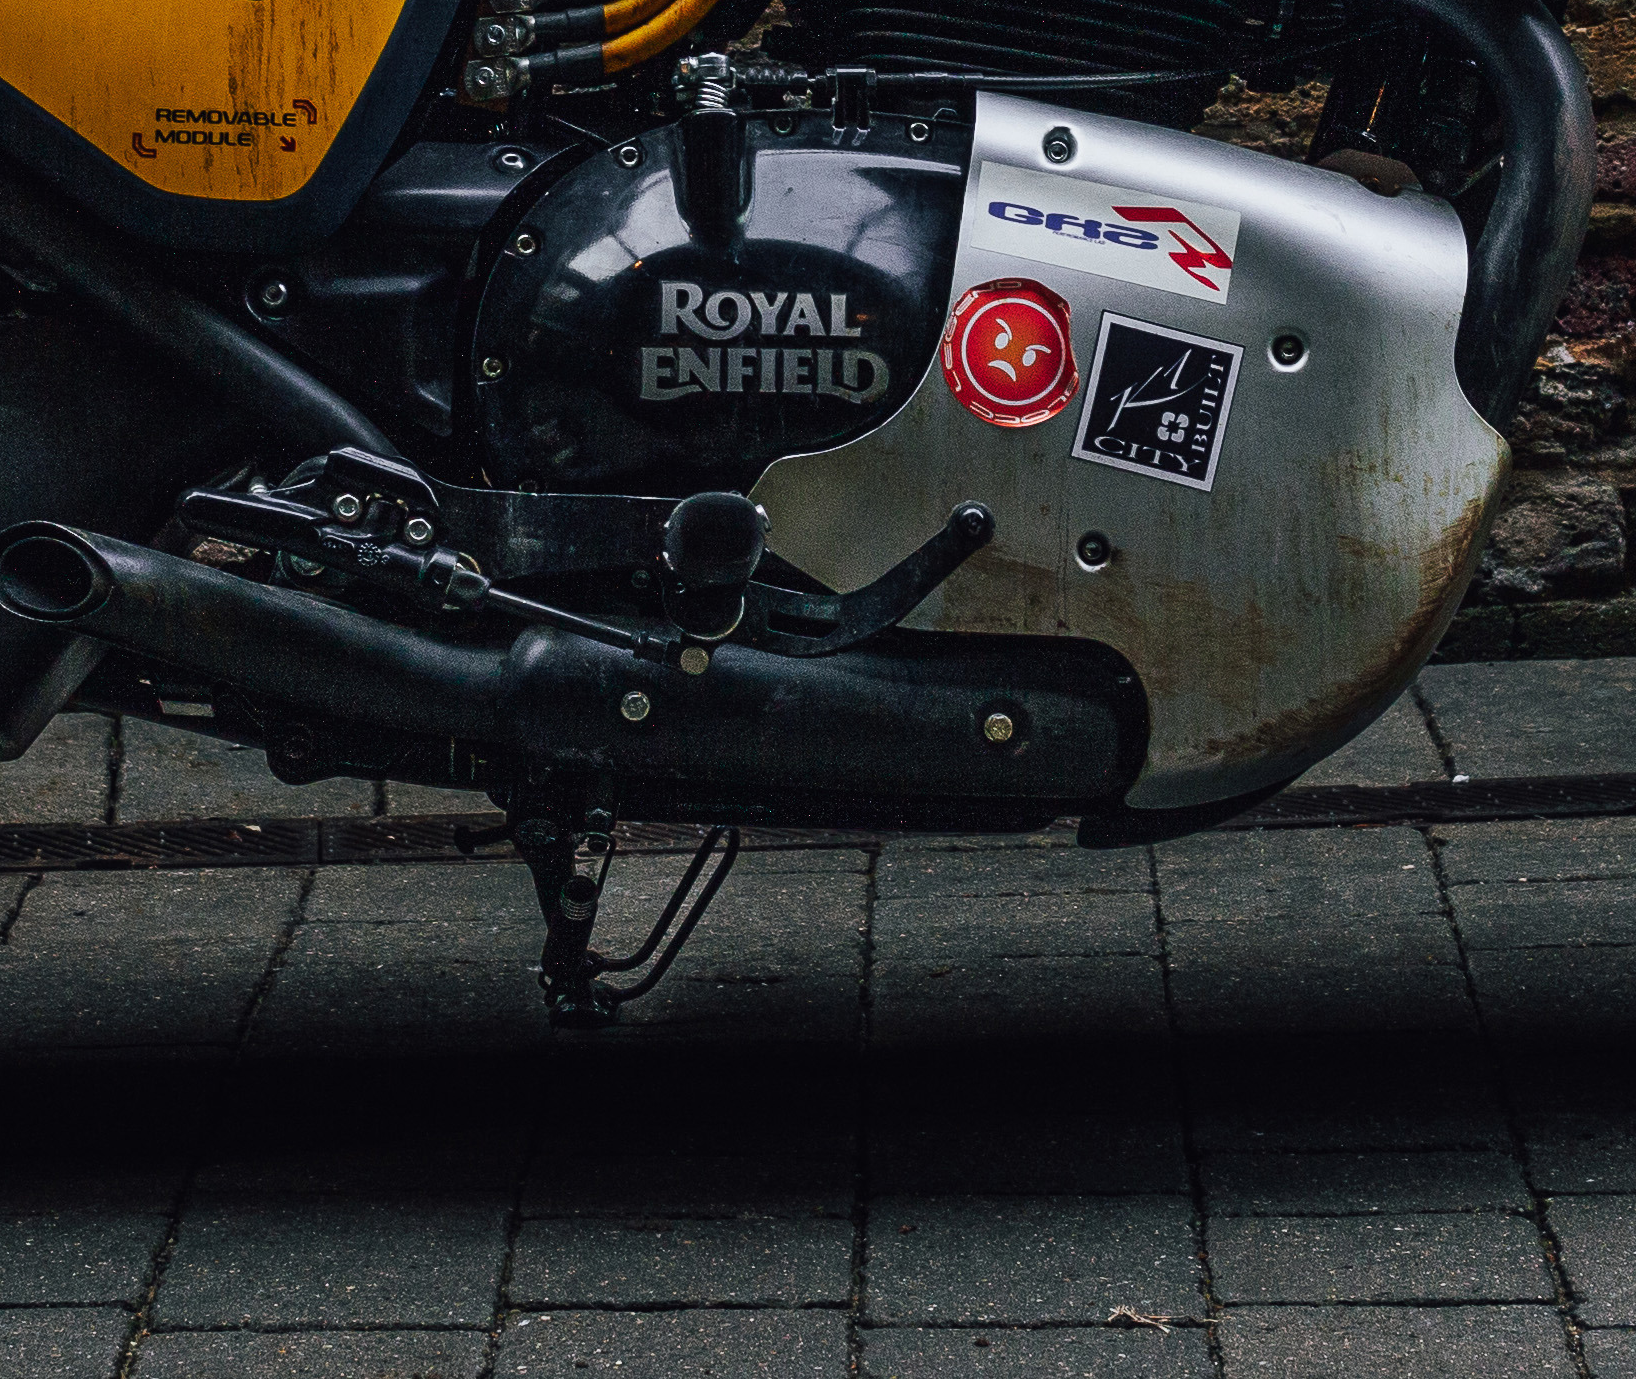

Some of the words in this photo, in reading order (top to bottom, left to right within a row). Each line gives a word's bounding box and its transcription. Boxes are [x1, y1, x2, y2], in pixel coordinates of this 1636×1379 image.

[154, 129, 253, 147] MODULE
[155, 108, 297, 127] REMOVABLE
[660, 280, 862, 341] ROYAL
[640, 347, 890, 404] ENFIELD
[1191, 354, 1225, 453] BUILT
[1093, 435, 1203, 473] CITY
